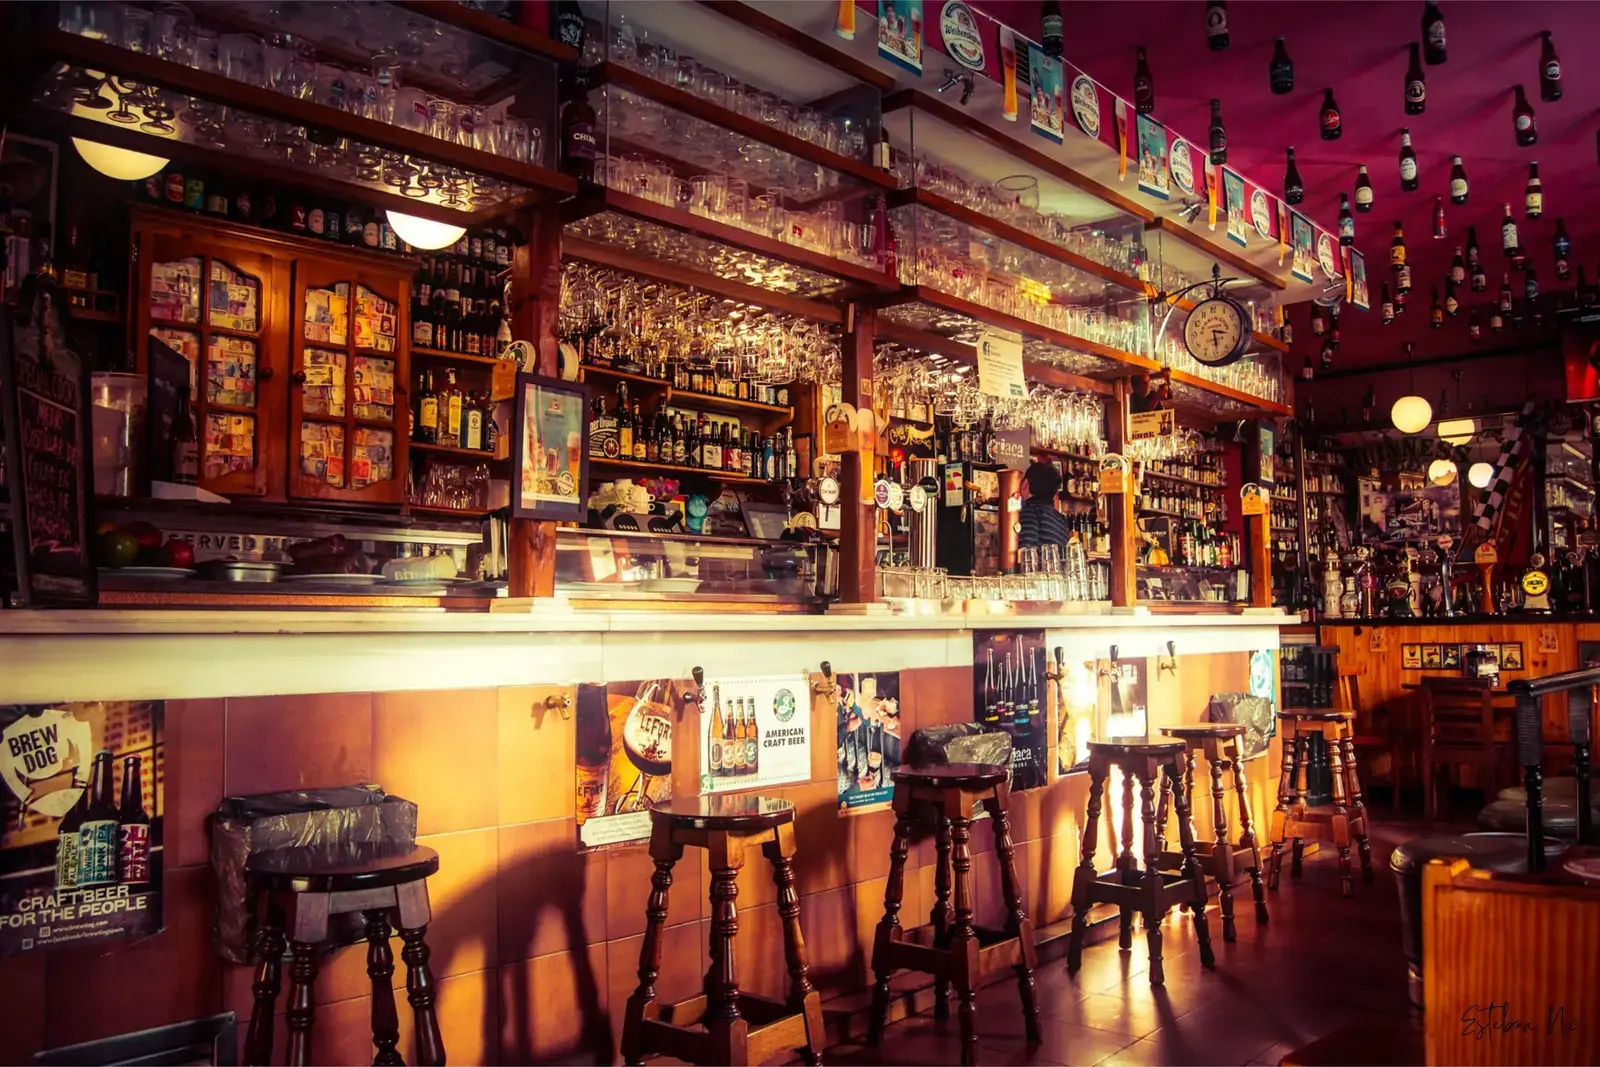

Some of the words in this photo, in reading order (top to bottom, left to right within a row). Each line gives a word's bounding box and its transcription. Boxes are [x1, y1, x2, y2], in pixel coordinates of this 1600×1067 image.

[8, 723, 59, 757] BREW
[763, 739, 786, 748] CRAFT
[788, 736, 805, 746] BEER
[765, 727, 804, 739] AMERICAN
[22, 745, 59, 774] DOG
[18, 891, 81, 912] CRAFT
[83, 884, 129, 903] BEER
[0, 911, 37, 930] FOR
[38, 906, 75, 923] THE
[79, 896, 147, 918] PEOPLE
